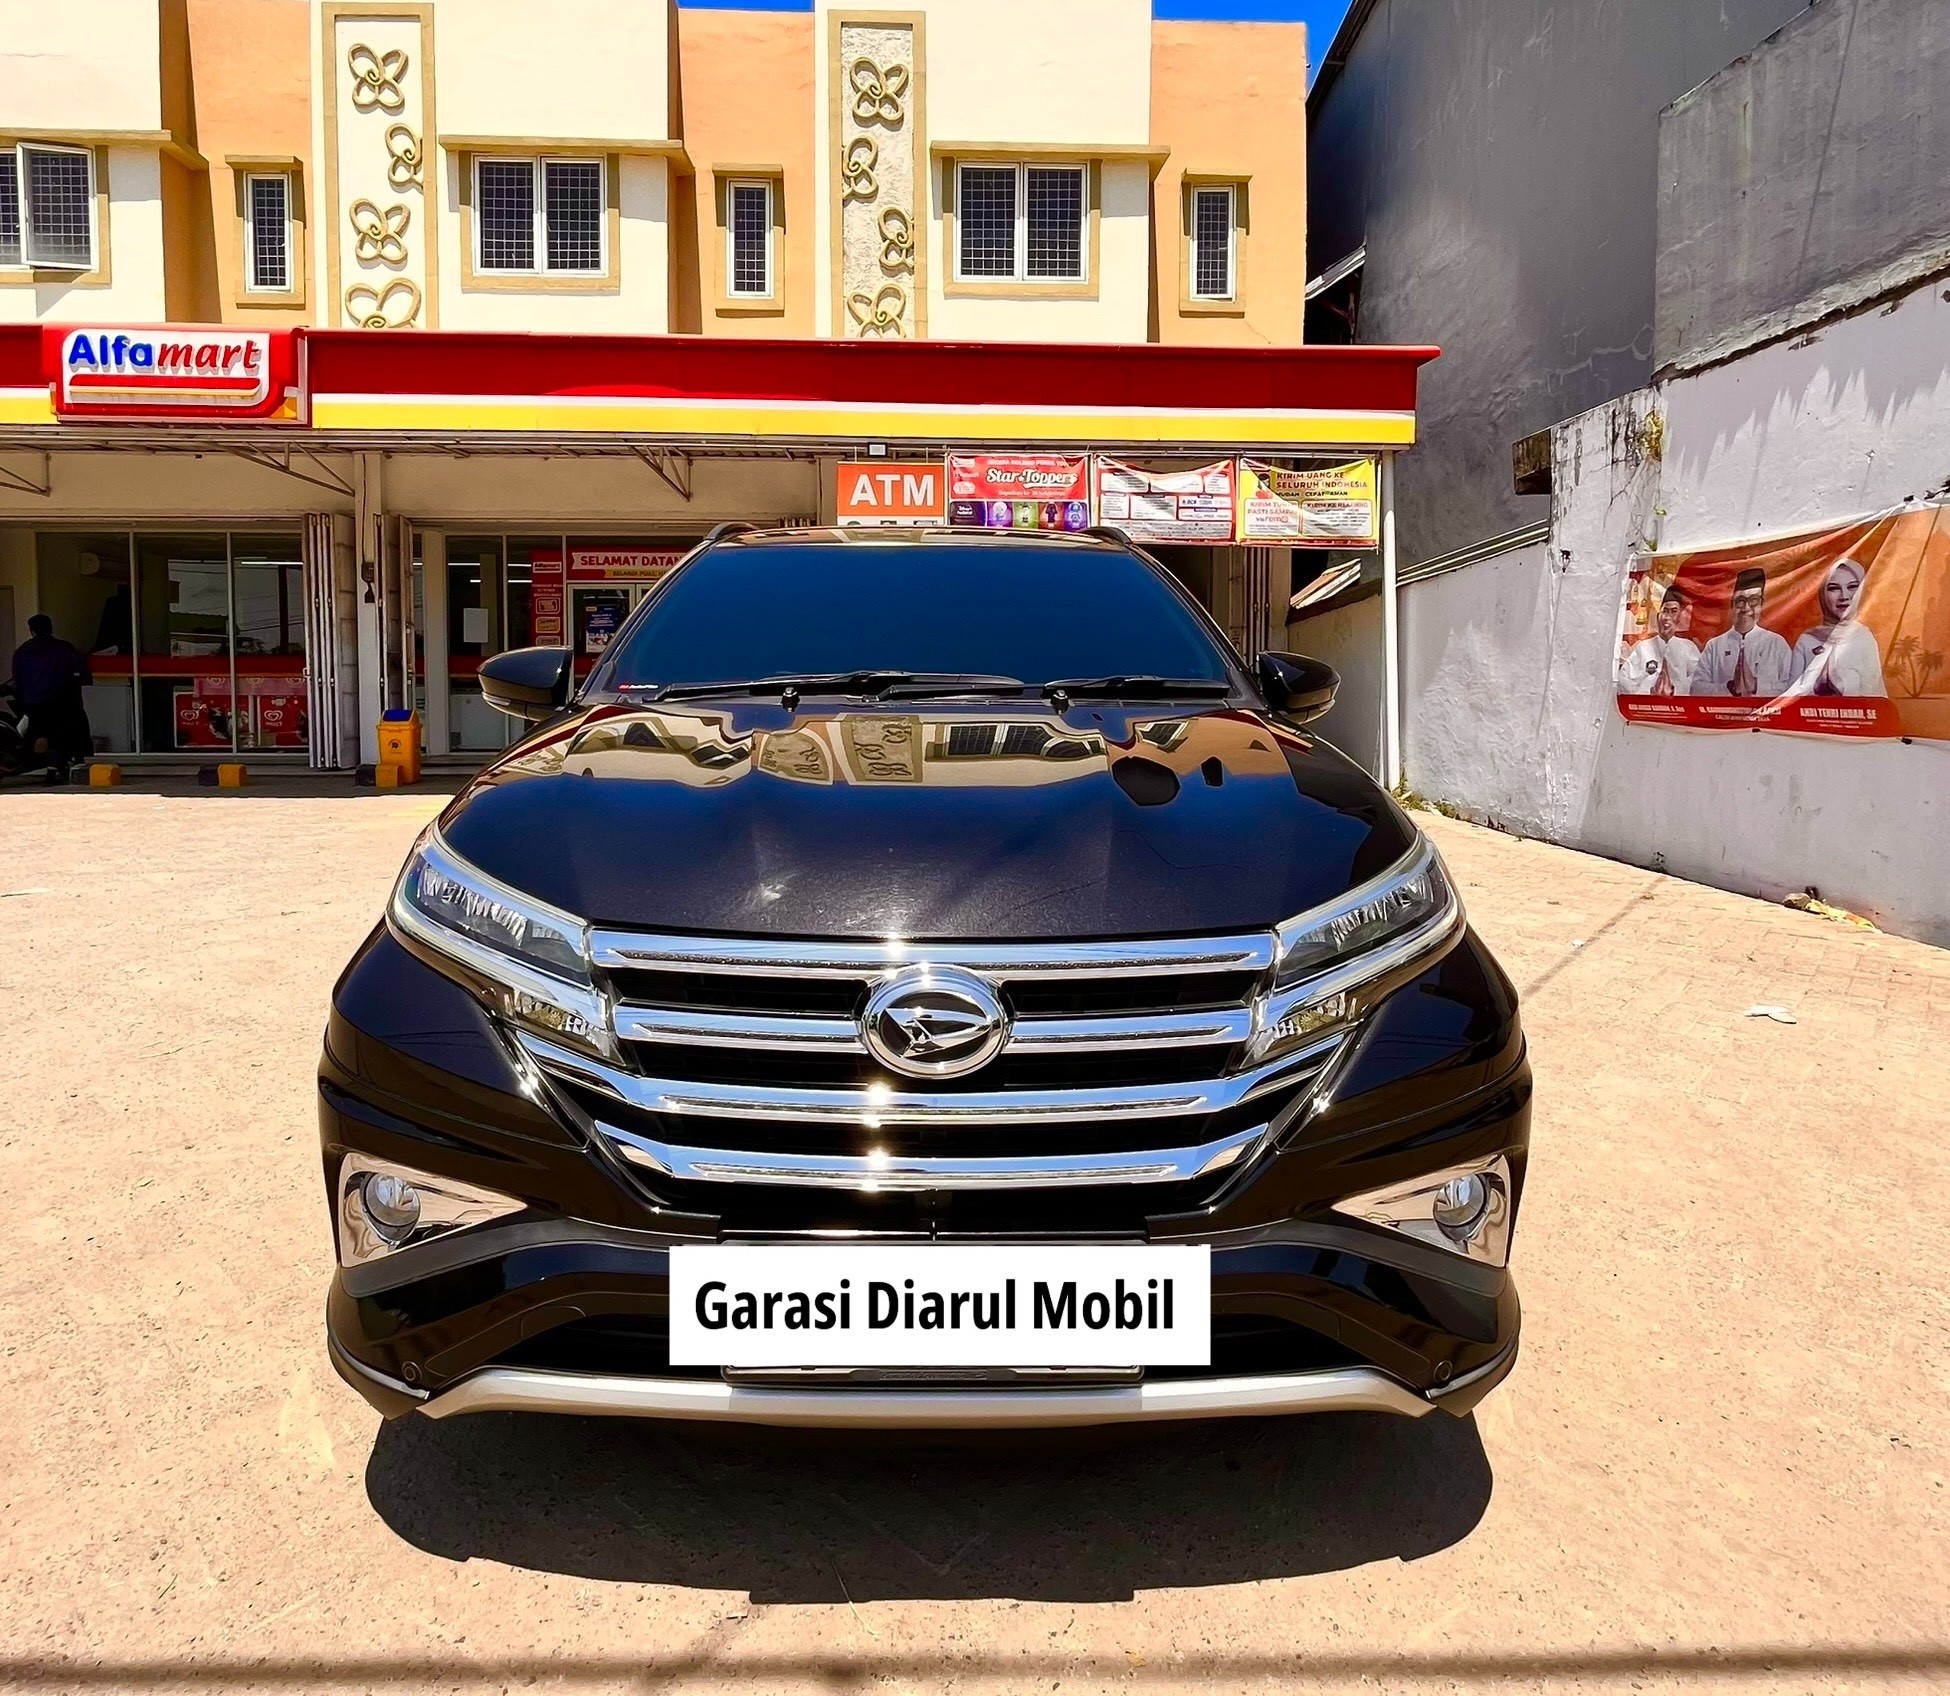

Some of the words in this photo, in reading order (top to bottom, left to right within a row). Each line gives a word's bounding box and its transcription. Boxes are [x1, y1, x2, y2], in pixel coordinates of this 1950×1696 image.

[68, 334, 260, 370] Alfamart
[986, 468, 1019, 483] Star
[1276, 472, 1304, 480] KIRIM
[1306, 471, 1332, 479] UANG
[849, 473, 934, 506] ATM
[1276, 480, 1319, 488] SELURUH
[1321, 480, 1368, 488] INDONESIA
[580, 555, 639, 566] SELAMAT
[641, 555, 680, 566] DATAN
